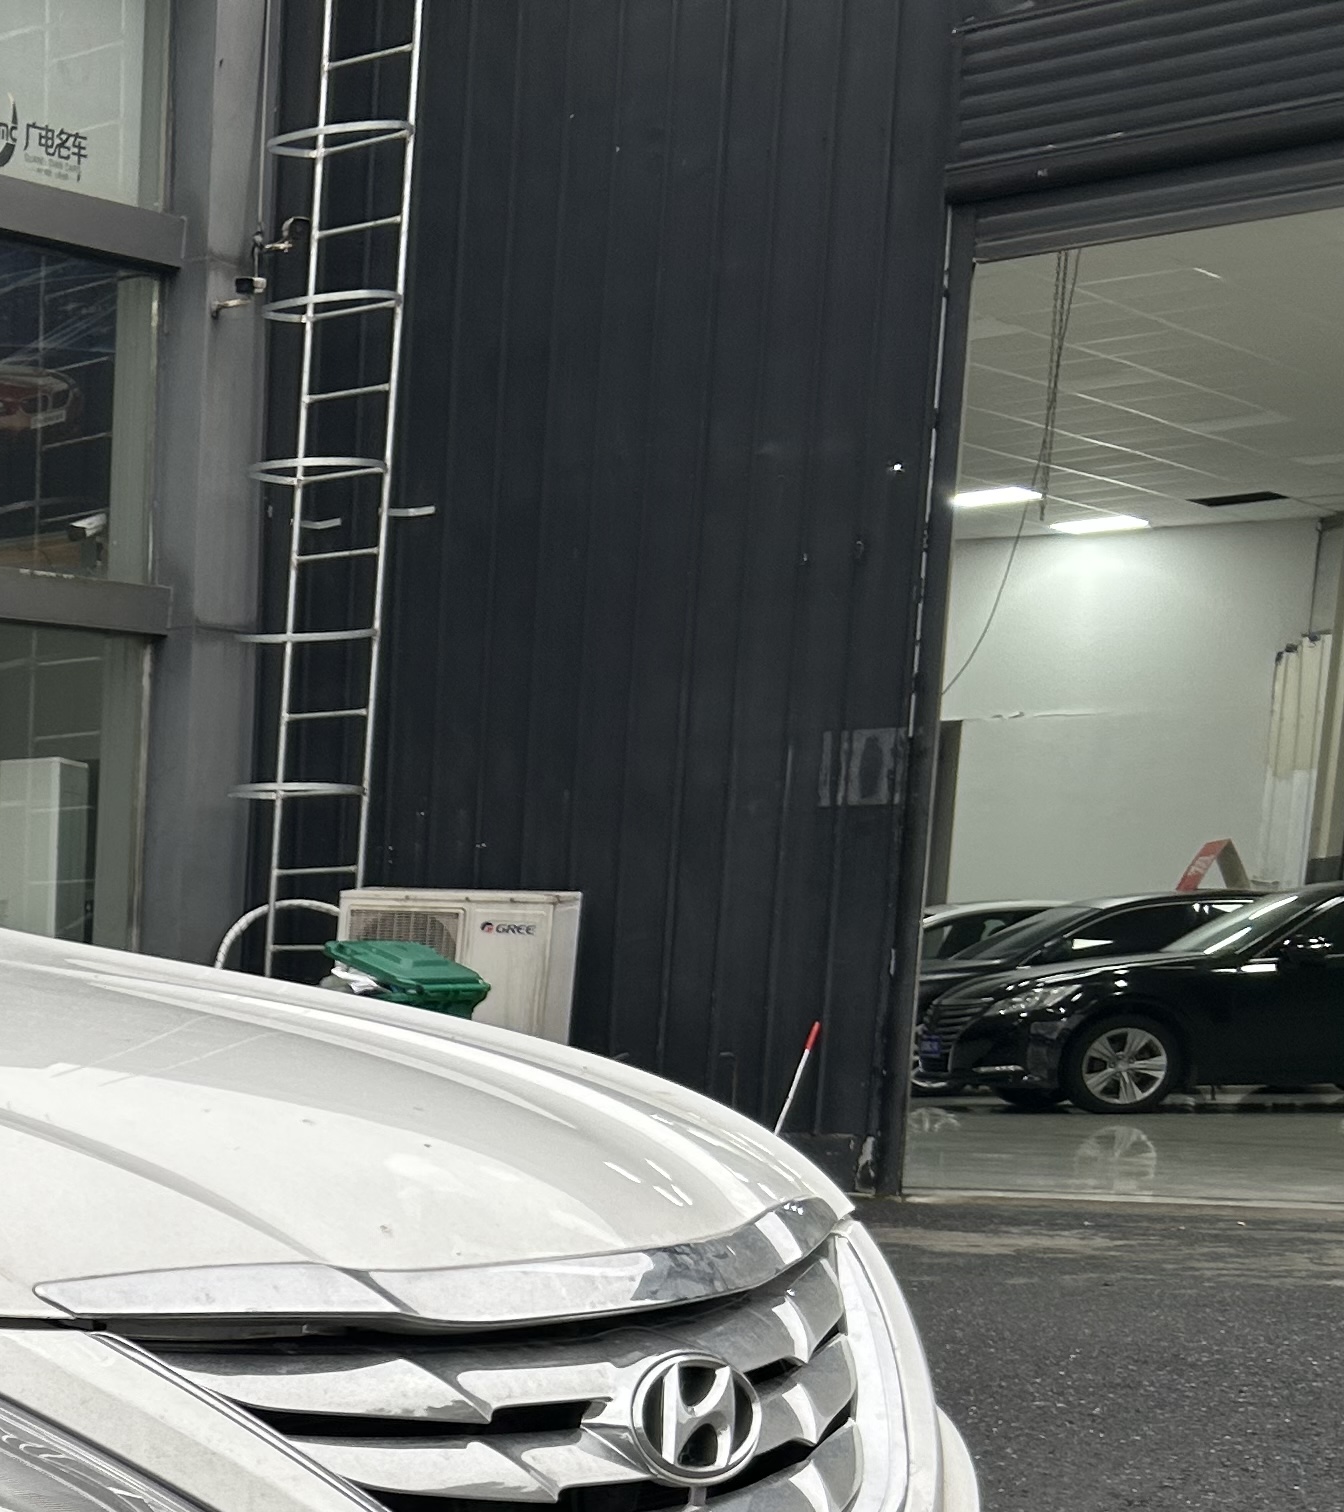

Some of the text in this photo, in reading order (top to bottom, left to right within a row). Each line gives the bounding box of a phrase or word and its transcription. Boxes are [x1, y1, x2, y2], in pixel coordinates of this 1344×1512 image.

[23, 121, 88, 182] 广电名车
[495, 923, 536, 936] GREE
